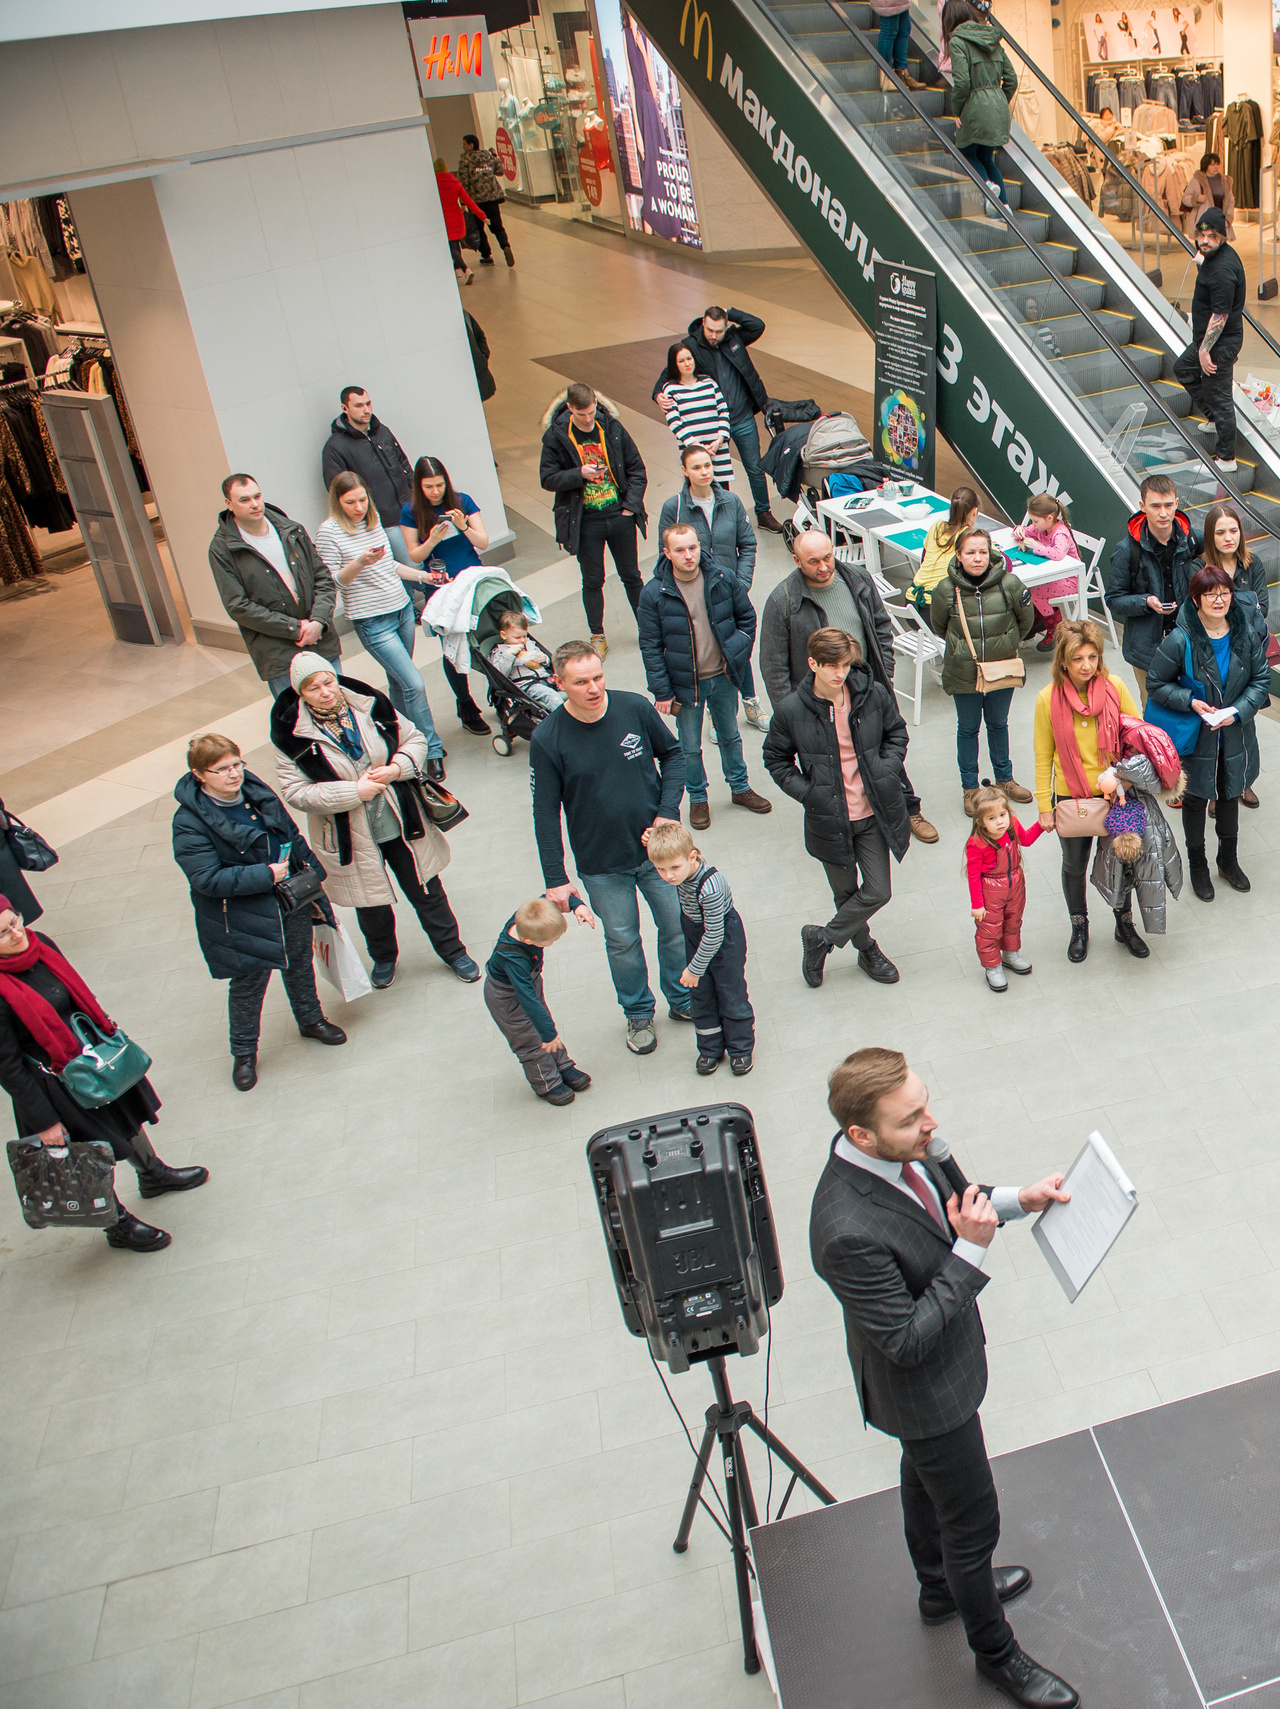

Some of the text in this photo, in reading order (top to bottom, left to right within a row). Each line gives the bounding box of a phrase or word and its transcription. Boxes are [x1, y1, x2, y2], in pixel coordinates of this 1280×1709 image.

[422, 31, 482, 81] H&M
[656, 160, 689, 183] PROUD
[663, 180, 693, 204] TO BE
[651, 196, 696, 223] A WOMAN
[937, 323, 963, 385] 3
[673, 1247, 717, 1275] JBL
